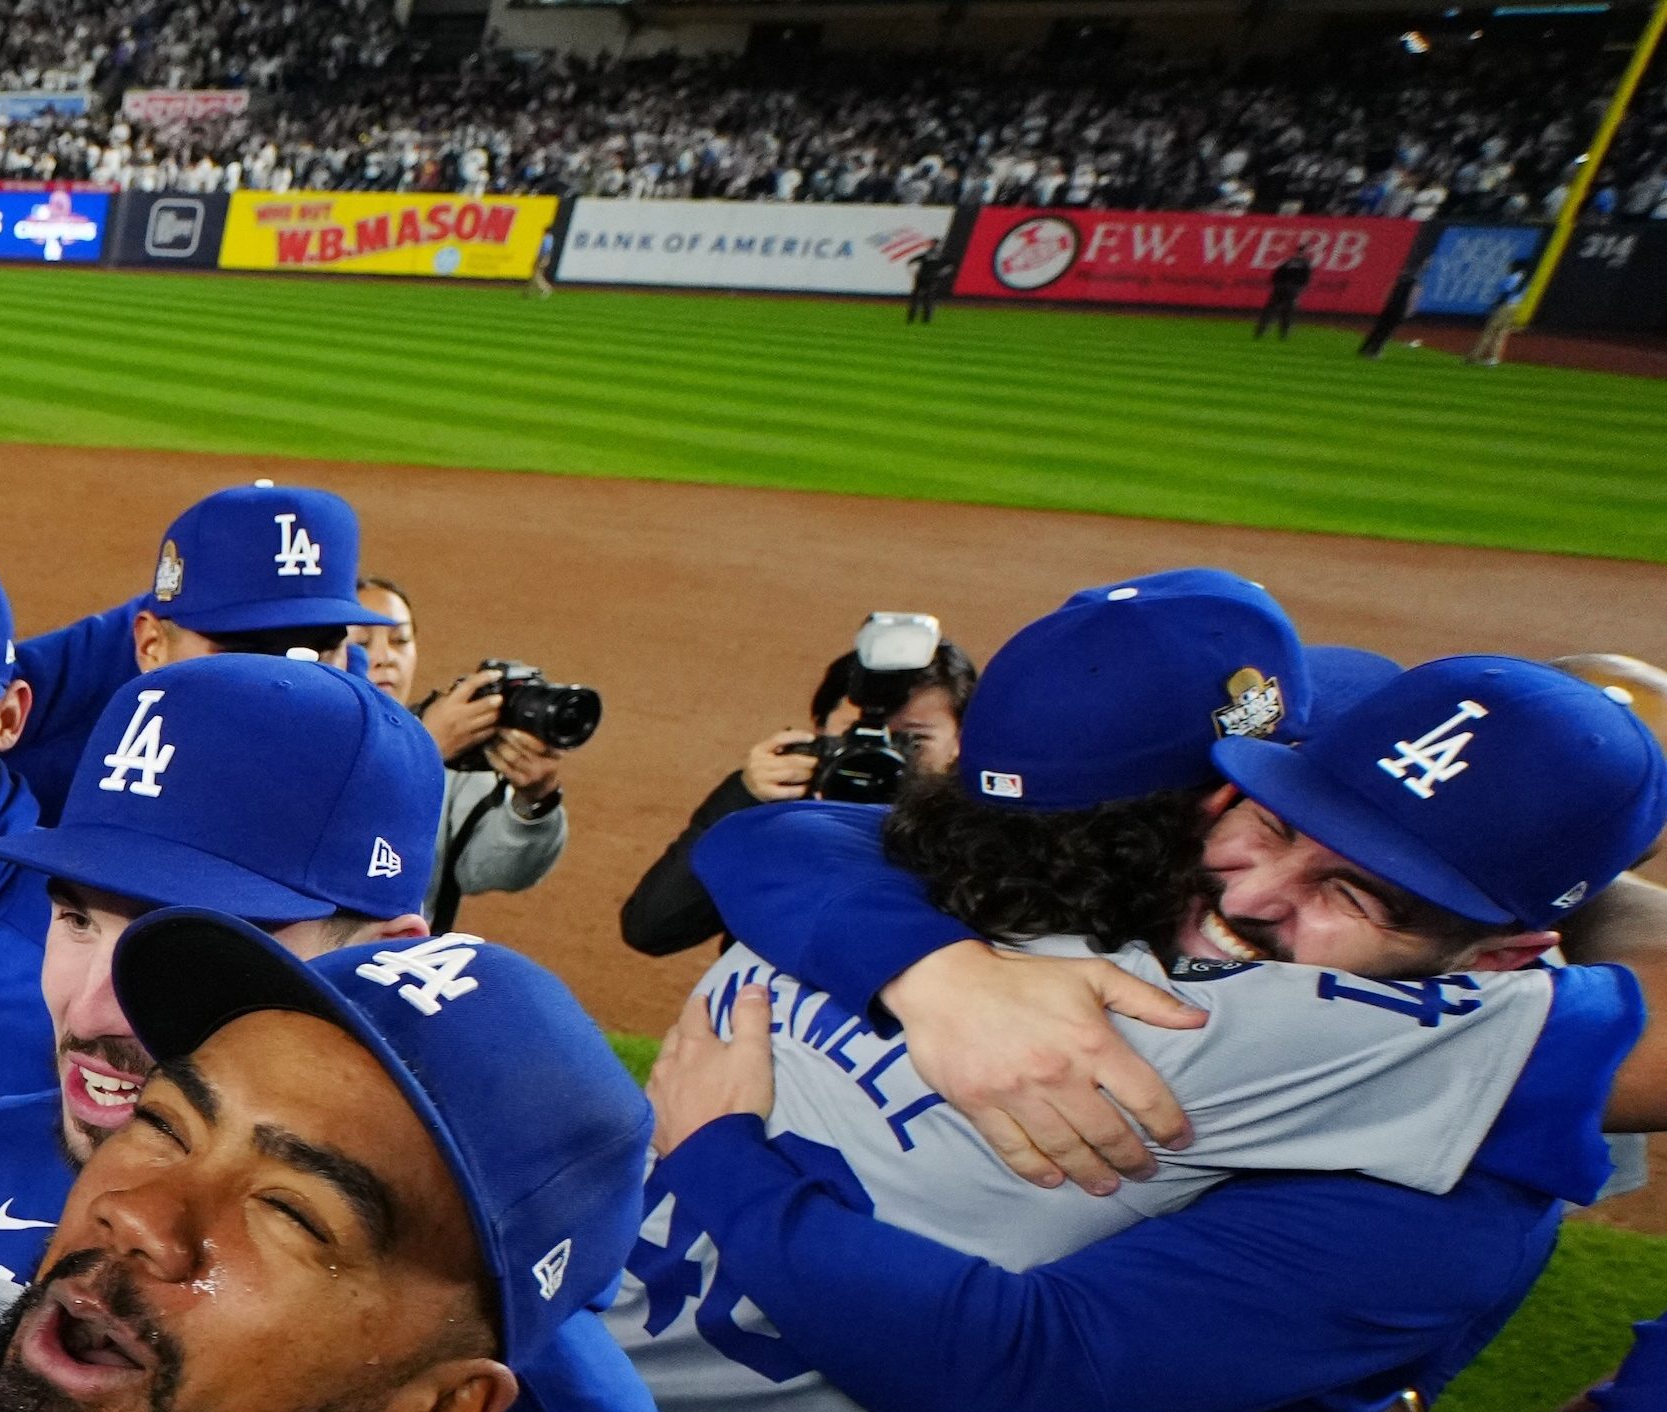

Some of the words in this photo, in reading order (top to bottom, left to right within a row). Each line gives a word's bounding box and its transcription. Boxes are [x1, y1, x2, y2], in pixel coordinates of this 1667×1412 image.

[573, 232, 655, 252] BANK
[663, 233, 702, 254] OF
[709, 234, 854, 260] AMERICA
[1202, 225, 1369, 272] WEBB
[274, 503, 323, 576] LA
[99, 690, 175, 798] LA
[1377, 700, 1489, 800] LA
[356, 932, 486, 1017] LA
